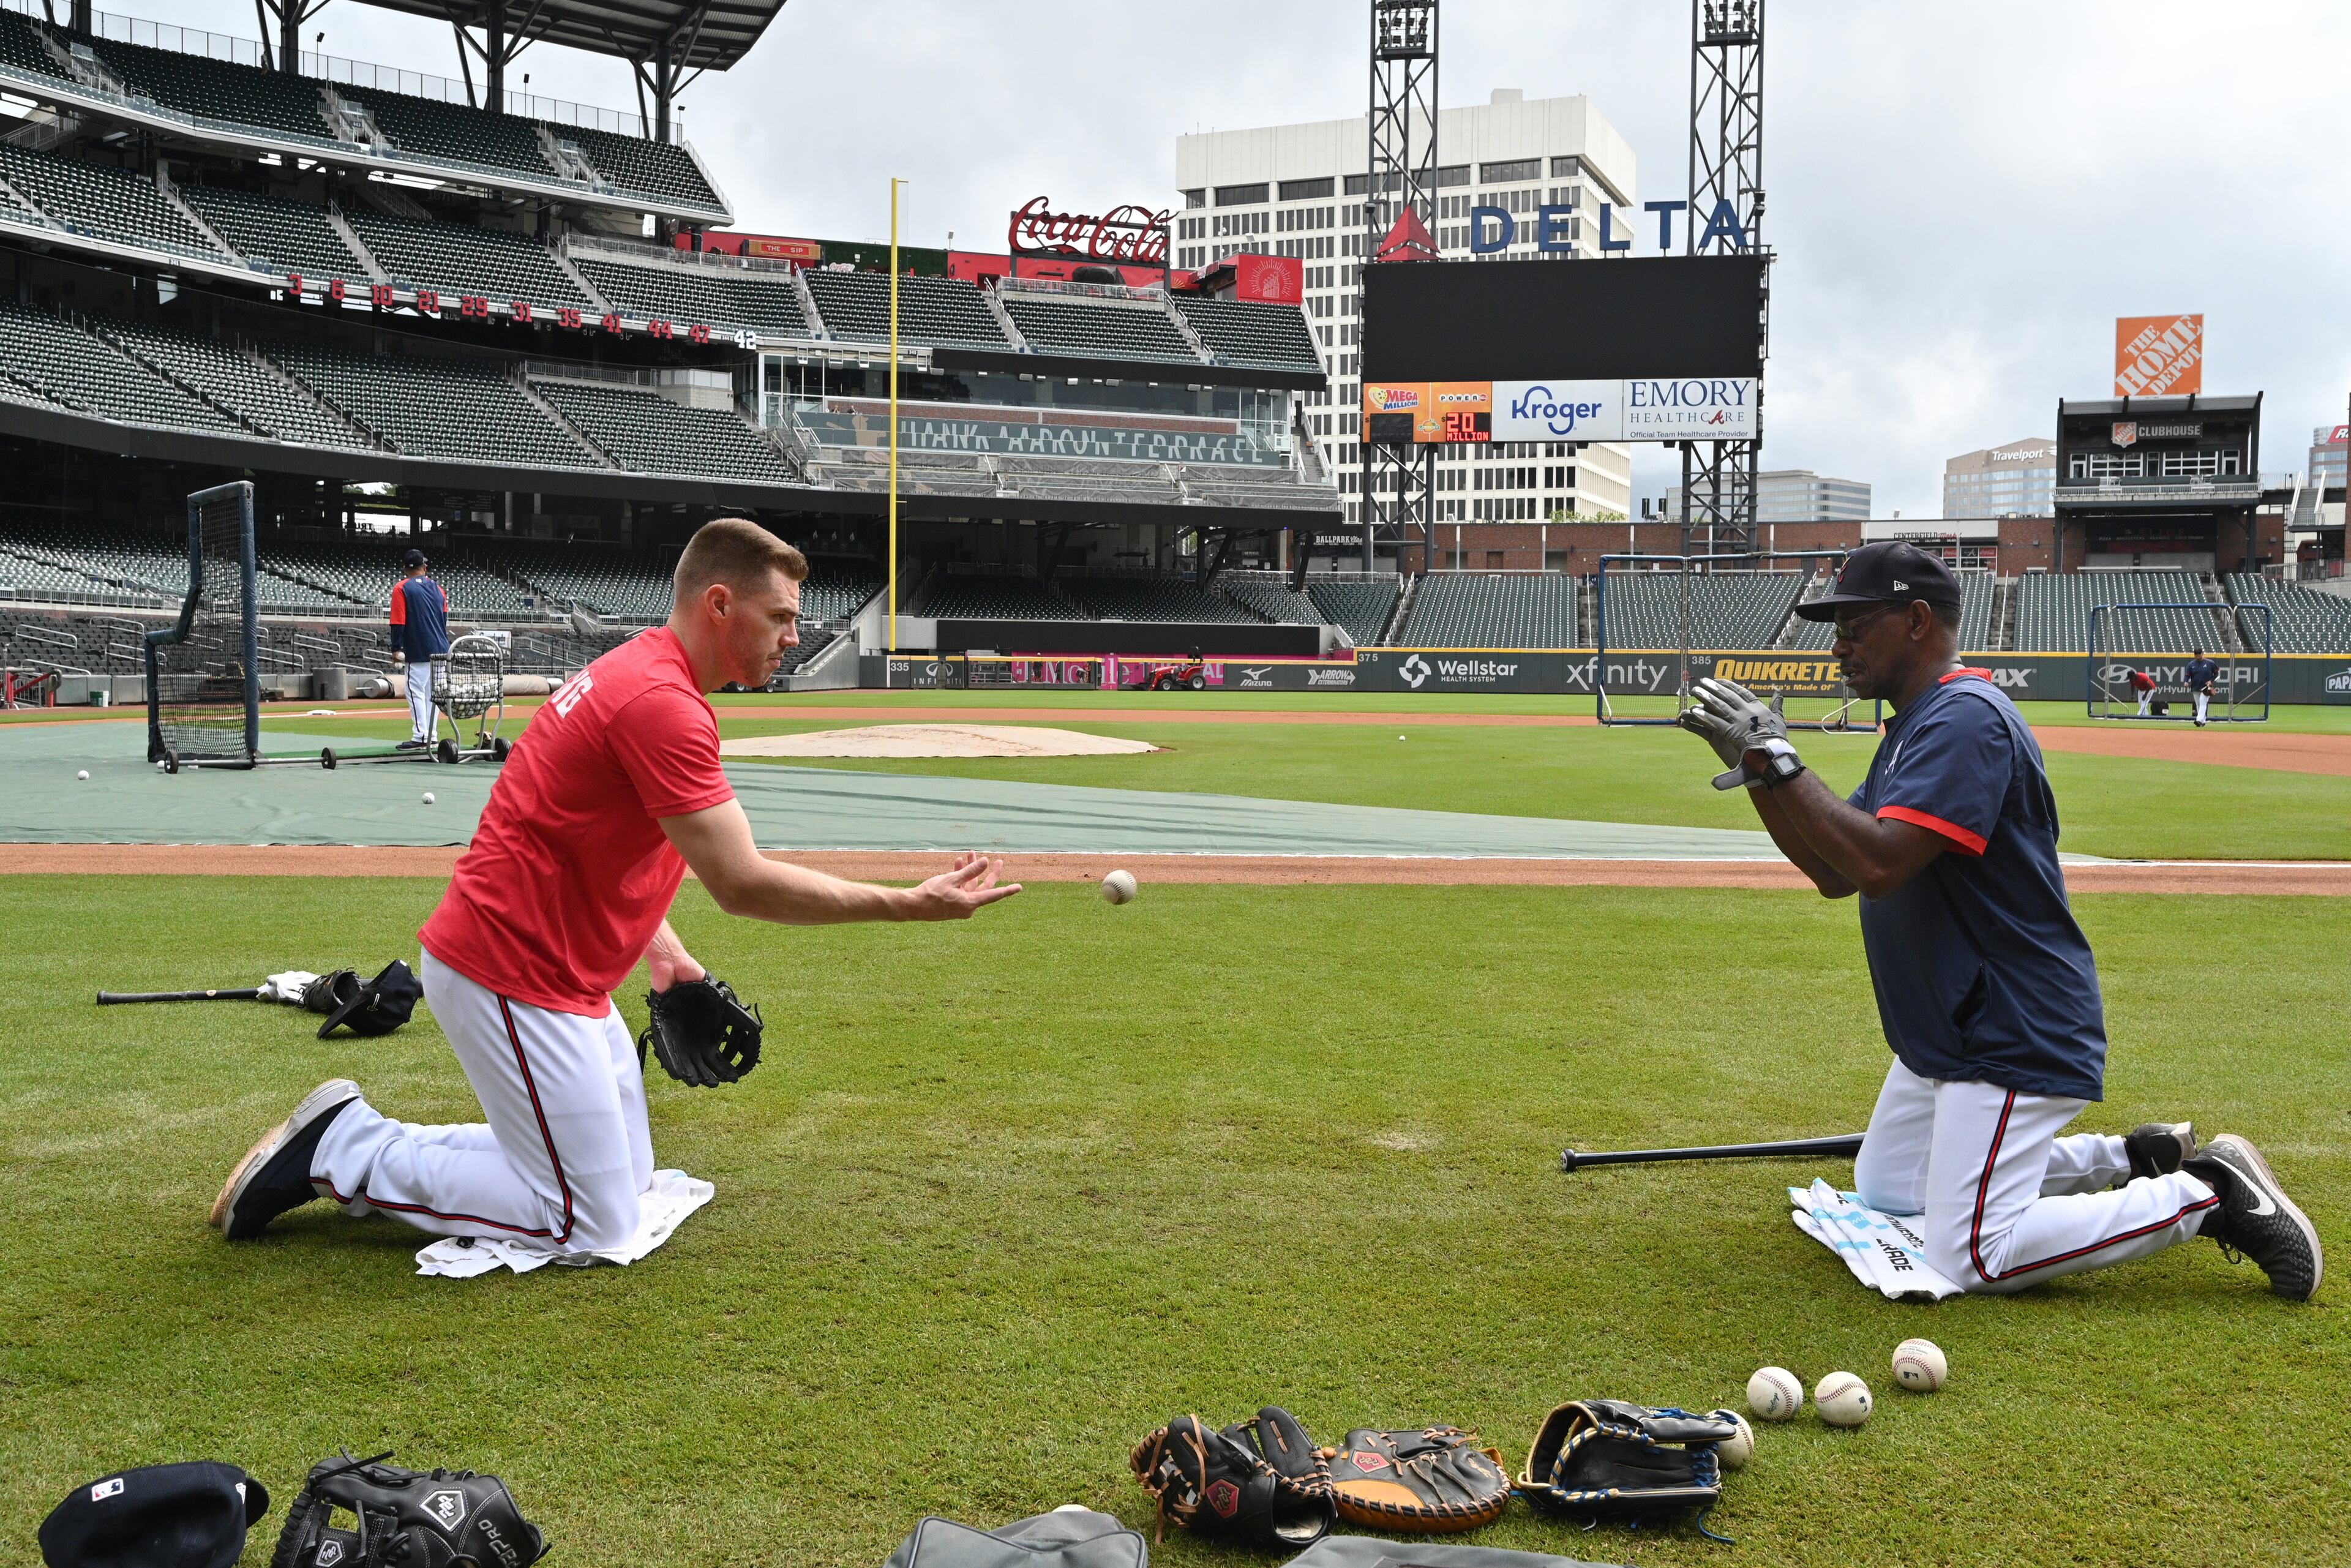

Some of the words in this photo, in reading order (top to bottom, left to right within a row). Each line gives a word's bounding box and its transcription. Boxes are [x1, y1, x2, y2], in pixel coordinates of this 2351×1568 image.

[1008, 196, 1179, 263] Coca-Cola
[1471, 199, 1749, 253] DELTA
[288, 274, 302, 295] 3
[331, 279, 345, 300] 6
[372, 283, 392, 306] 10
[418, 290, 440, 312] 21
[462, 296, 488, 318] 29
[512, 302, 532, 323] 31
[557, 307, 582, 329] 35
[601, 313, 622, 334] 41
[648, 319, 673, 339] 44
[689, 324, 711, 343] 47
[734, 329, 756, 350] 42
[2124, 324, 2160, 358] THE
[2115, 315, 2203, 396] HOME
[2148, 343, 2202, 395] DEPOT
[1385, 389, 1418, 402] MEGA
[1629, 380, 1751, 408] EMORY
[1383, 400, 1418, 410] MILLIONS
[1512, 386, 1602, 435] Kroger
[1447, 413, 1474, 432] 20
[1630, 410, 1744, 425] HEALTHCARE
[1447, 432, 1488, 441] MILLION
[2139, 425, 2200, 437] CLUBHOUSE
[901, 421, 989, 450] HANK
[999, 426, 1110, 456] AARON
[1114, 432, 1262, 463] TERRACE
[1992, 449, 2044, 461] Travelport
[890, 662, 909, 672] 335
[1319, 670, 1347, 680] ARROW
[1438, 660, 1518, 676] Wellstar
[1567, 656, 1668, 691] xfnity
[1714, 659, 1842, 681] QUIKRETE
[1990, 669, 2032, 687] AX
